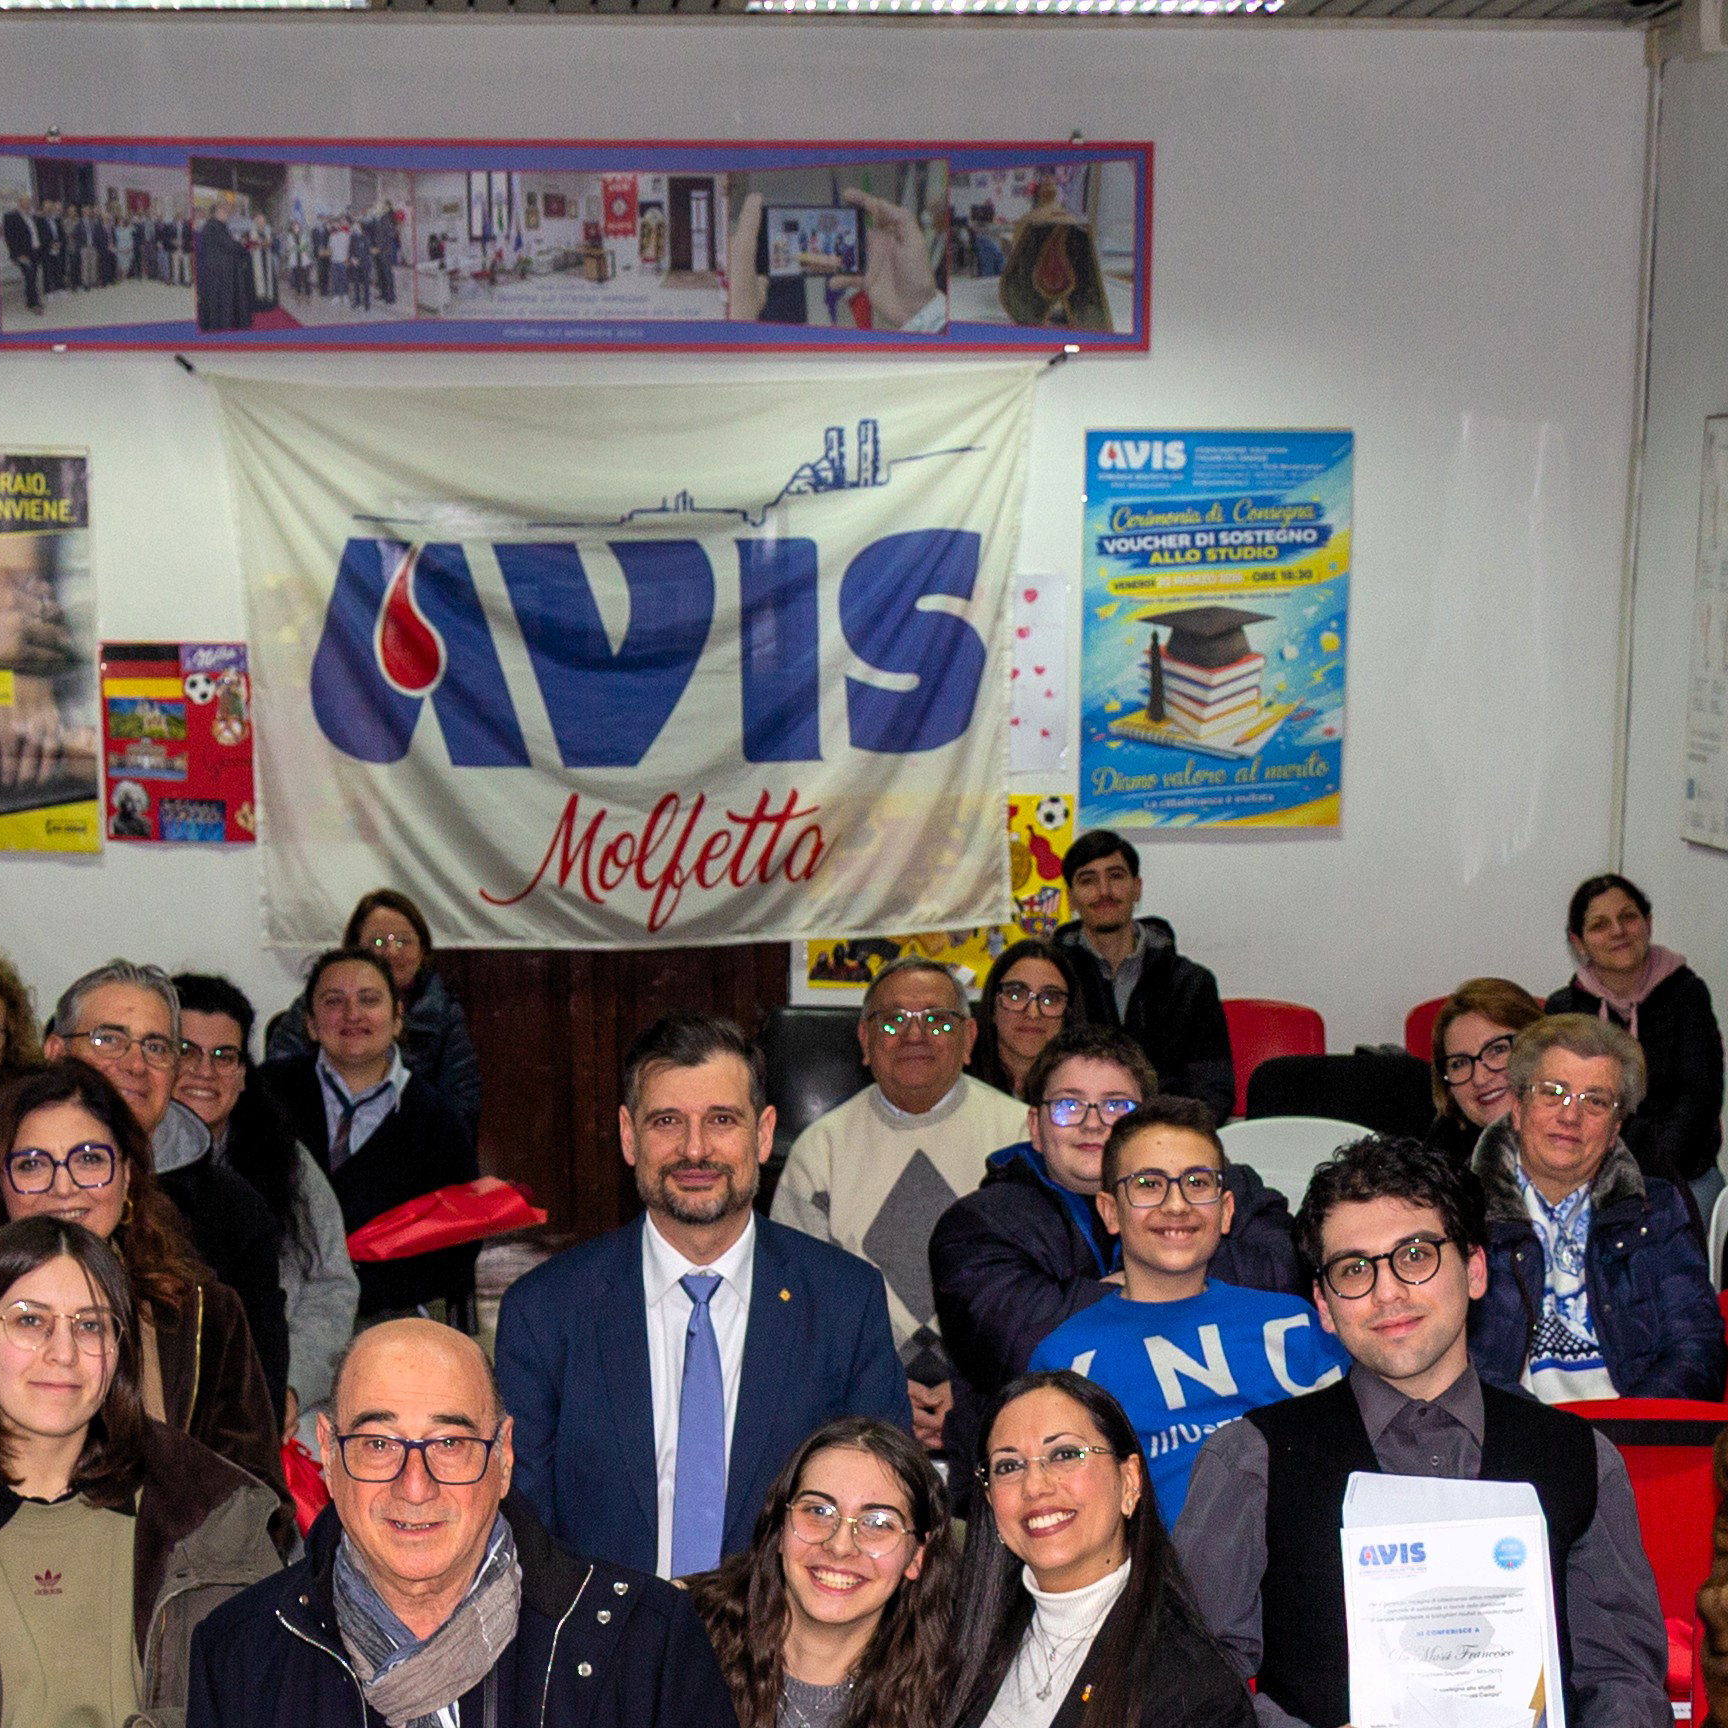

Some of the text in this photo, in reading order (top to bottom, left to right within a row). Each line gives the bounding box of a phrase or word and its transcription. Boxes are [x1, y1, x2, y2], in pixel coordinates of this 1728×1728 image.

[1098, 440, 1187, 470] AVIS
[1112, 498, 1317, 534] Cerimonia di Consegna
[1103, 528, 1318, 554] VOUCHER DI SOSTEGNO
[1149, 546, 1278, 566] ALLO STUDIO
[1252, 572, 1277, 583] ORE
[309, 527, 988, 768] AVIS
[1162, 760, 1226, 788] valore
[1234, 756, 1262, 783] al
[1265, 751, 1329, 780] merito
[480, 787, 829, 934] Molfetta
[1071, 1313, 1343, 1410] NC
[1359, 1542, 1427, 1567] AVIS
[1426, 1628, 1470, 1636] CONFERISCE
